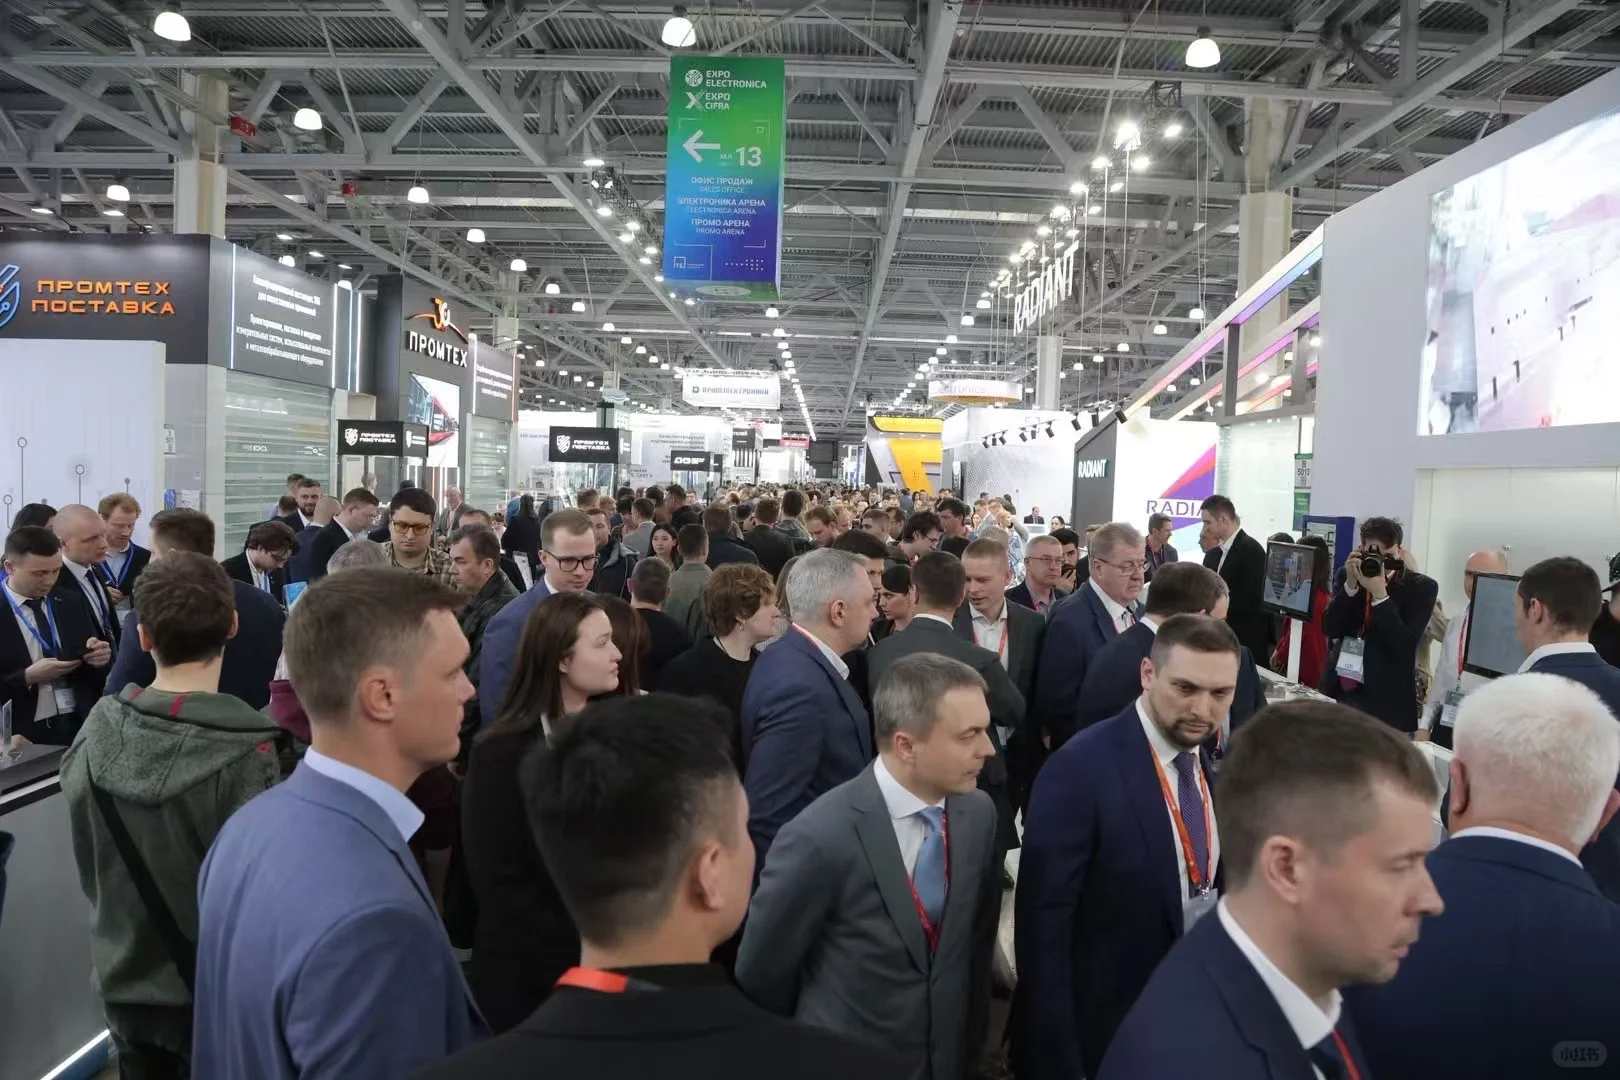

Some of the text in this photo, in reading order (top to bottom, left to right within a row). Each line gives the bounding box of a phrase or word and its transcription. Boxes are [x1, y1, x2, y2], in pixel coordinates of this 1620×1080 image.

[706, 70, 730, 78] EXPO
[705, 79, 767, 88] ELECTRONICA
[705, 92, 731, 101] EXPO
[705, 102, 730, 110] CIFRA
[735, 146, 762, 167] 13
[691, 176, 753, 186] ОФИС ПРОДАЖ
[738, 199, 766, 207] АРЕНА
[733, 207, 756, 215] ARENA
[691, 218, 750, 227] ПРОМО АРЕНА
[37, 279, 170, 295] ПРОМТЕХ
[1013, 239, 1079, 337] RADIANT
[31, 299, 176, 315] ПОСТАВКА
[409, 330, 468, 368] ПРОМТЕХ
[1078, 459, 1107, 478] RADIANT
